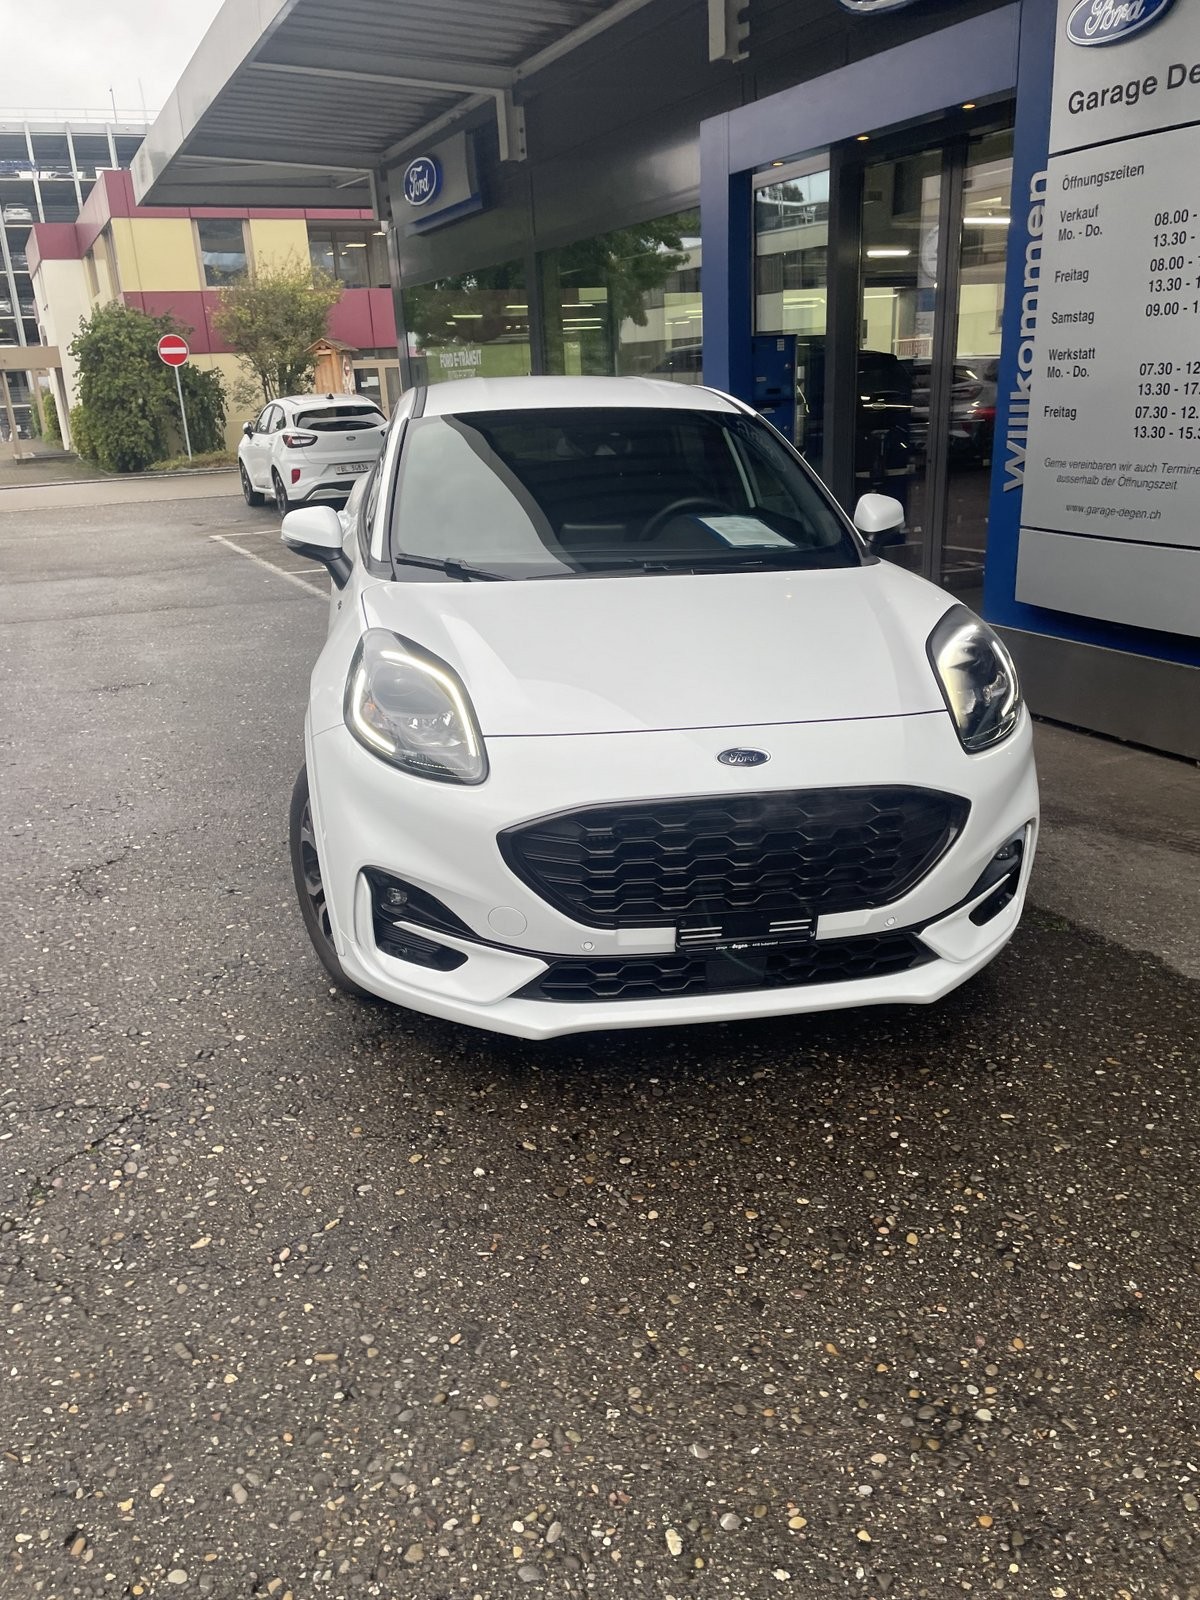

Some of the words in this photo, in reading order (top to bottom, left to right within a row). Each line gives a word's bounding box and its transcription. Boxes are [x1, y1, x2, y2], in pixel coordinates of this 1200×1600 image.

[1084, 0, 1146, 36] Ford
[1068, 75, 1158, 114] Garage
[1062, 163, 1145, 191] Öffnungszeiten
[1060, 204, 1099, 223] Verkauf
[1154, 209, 1189, 227] 08.00
[1058, 228, 1076, 242] Mo.
[1085, 224, 1103, 238] Do.
[1153, 231, 1187, 248] 13.30
[1149, 255, 1184, 272] 08.00
[1054, 268, 1090, 284] Freitag
[1148, 277, 1182, 293] 13.30
[1145, 301, 1179, 317] 09.00
[1051, 310, 1095, 325] Samstag
[1003, 170, 1049, 492] Willkommen
[1049, 347, 1096, 361] Werkstatt
[1047, 366, 1064, 378] Mo.
[1072, 365, 1090, 378] Do.
[1139, 362, 1173, 376] 07.30
[1138, 382, 1171, 396] 13.30
[1043, 405, 1077, 421] Freitag
[1135, 406, 1168, 419] 07.30
[1180, 406, 1199, 419] 12.
[1133, 426, 1166, 439] 13.30
[1044, 457, 1067, 469] Gerne
[1068, 460, 1117, 471] vereinbaren
[1118, 461, 1132, 472] wir
[1134, 462, 1157, 473] auch
[1161, 462, 1200, 475] Termine
[1056, 474, 1099, 485] ausserhalb
[1101, 476, 1115, 486] der
[1065, 503, 1162, 520] www.garage-degen.ch
